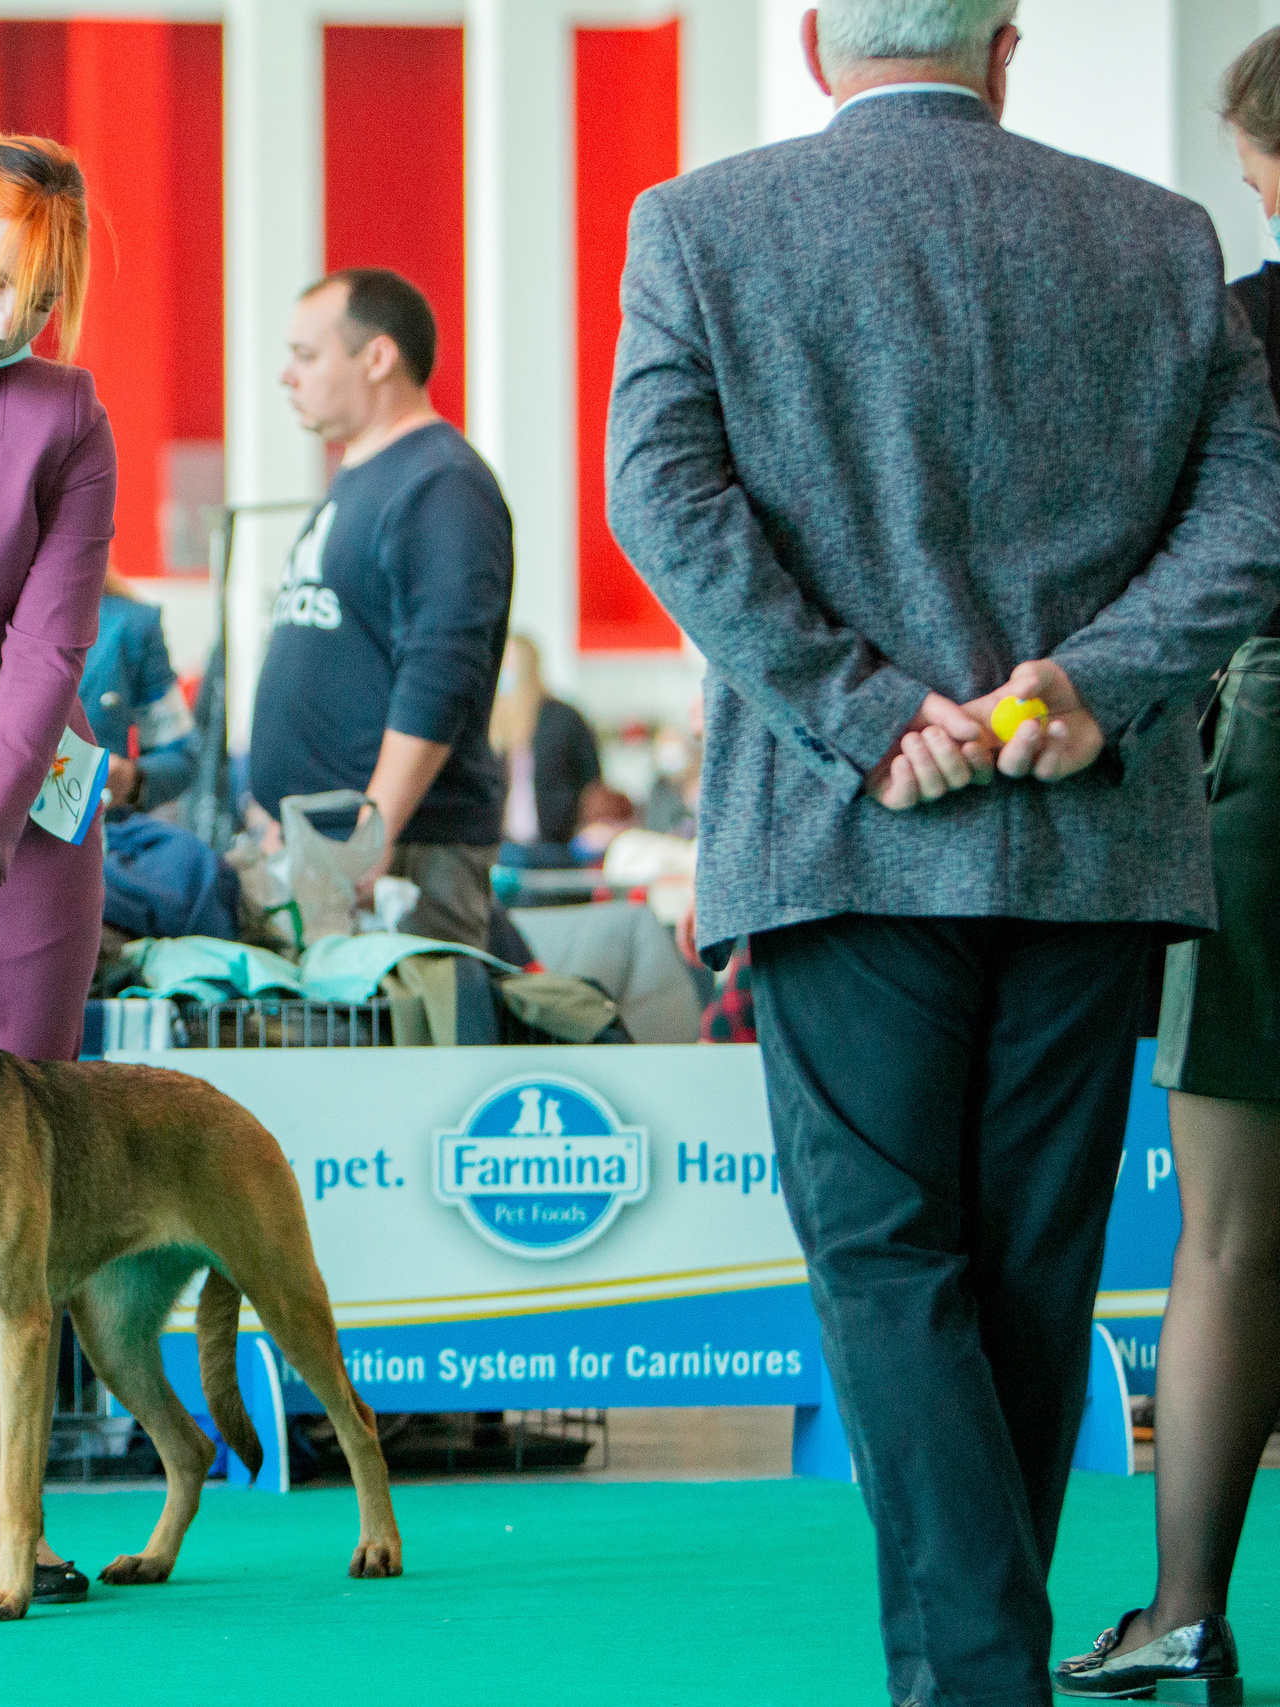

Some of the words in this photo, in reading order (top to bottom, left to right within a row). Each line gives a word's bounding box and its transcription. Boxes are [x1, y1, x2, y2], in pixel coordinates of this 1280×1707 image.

[315, 1147, 404, 1201] pet.
[455, 1145, 626, 1186] Farmina
[495, 1203, 525, 1224] Pet
[531, 1201, 588, 1223] Foods
[439, 1348, 556, 1388] System
[569, 1345, 614, 1379] for
[625, 1342, 802, 1379] Carnivores
